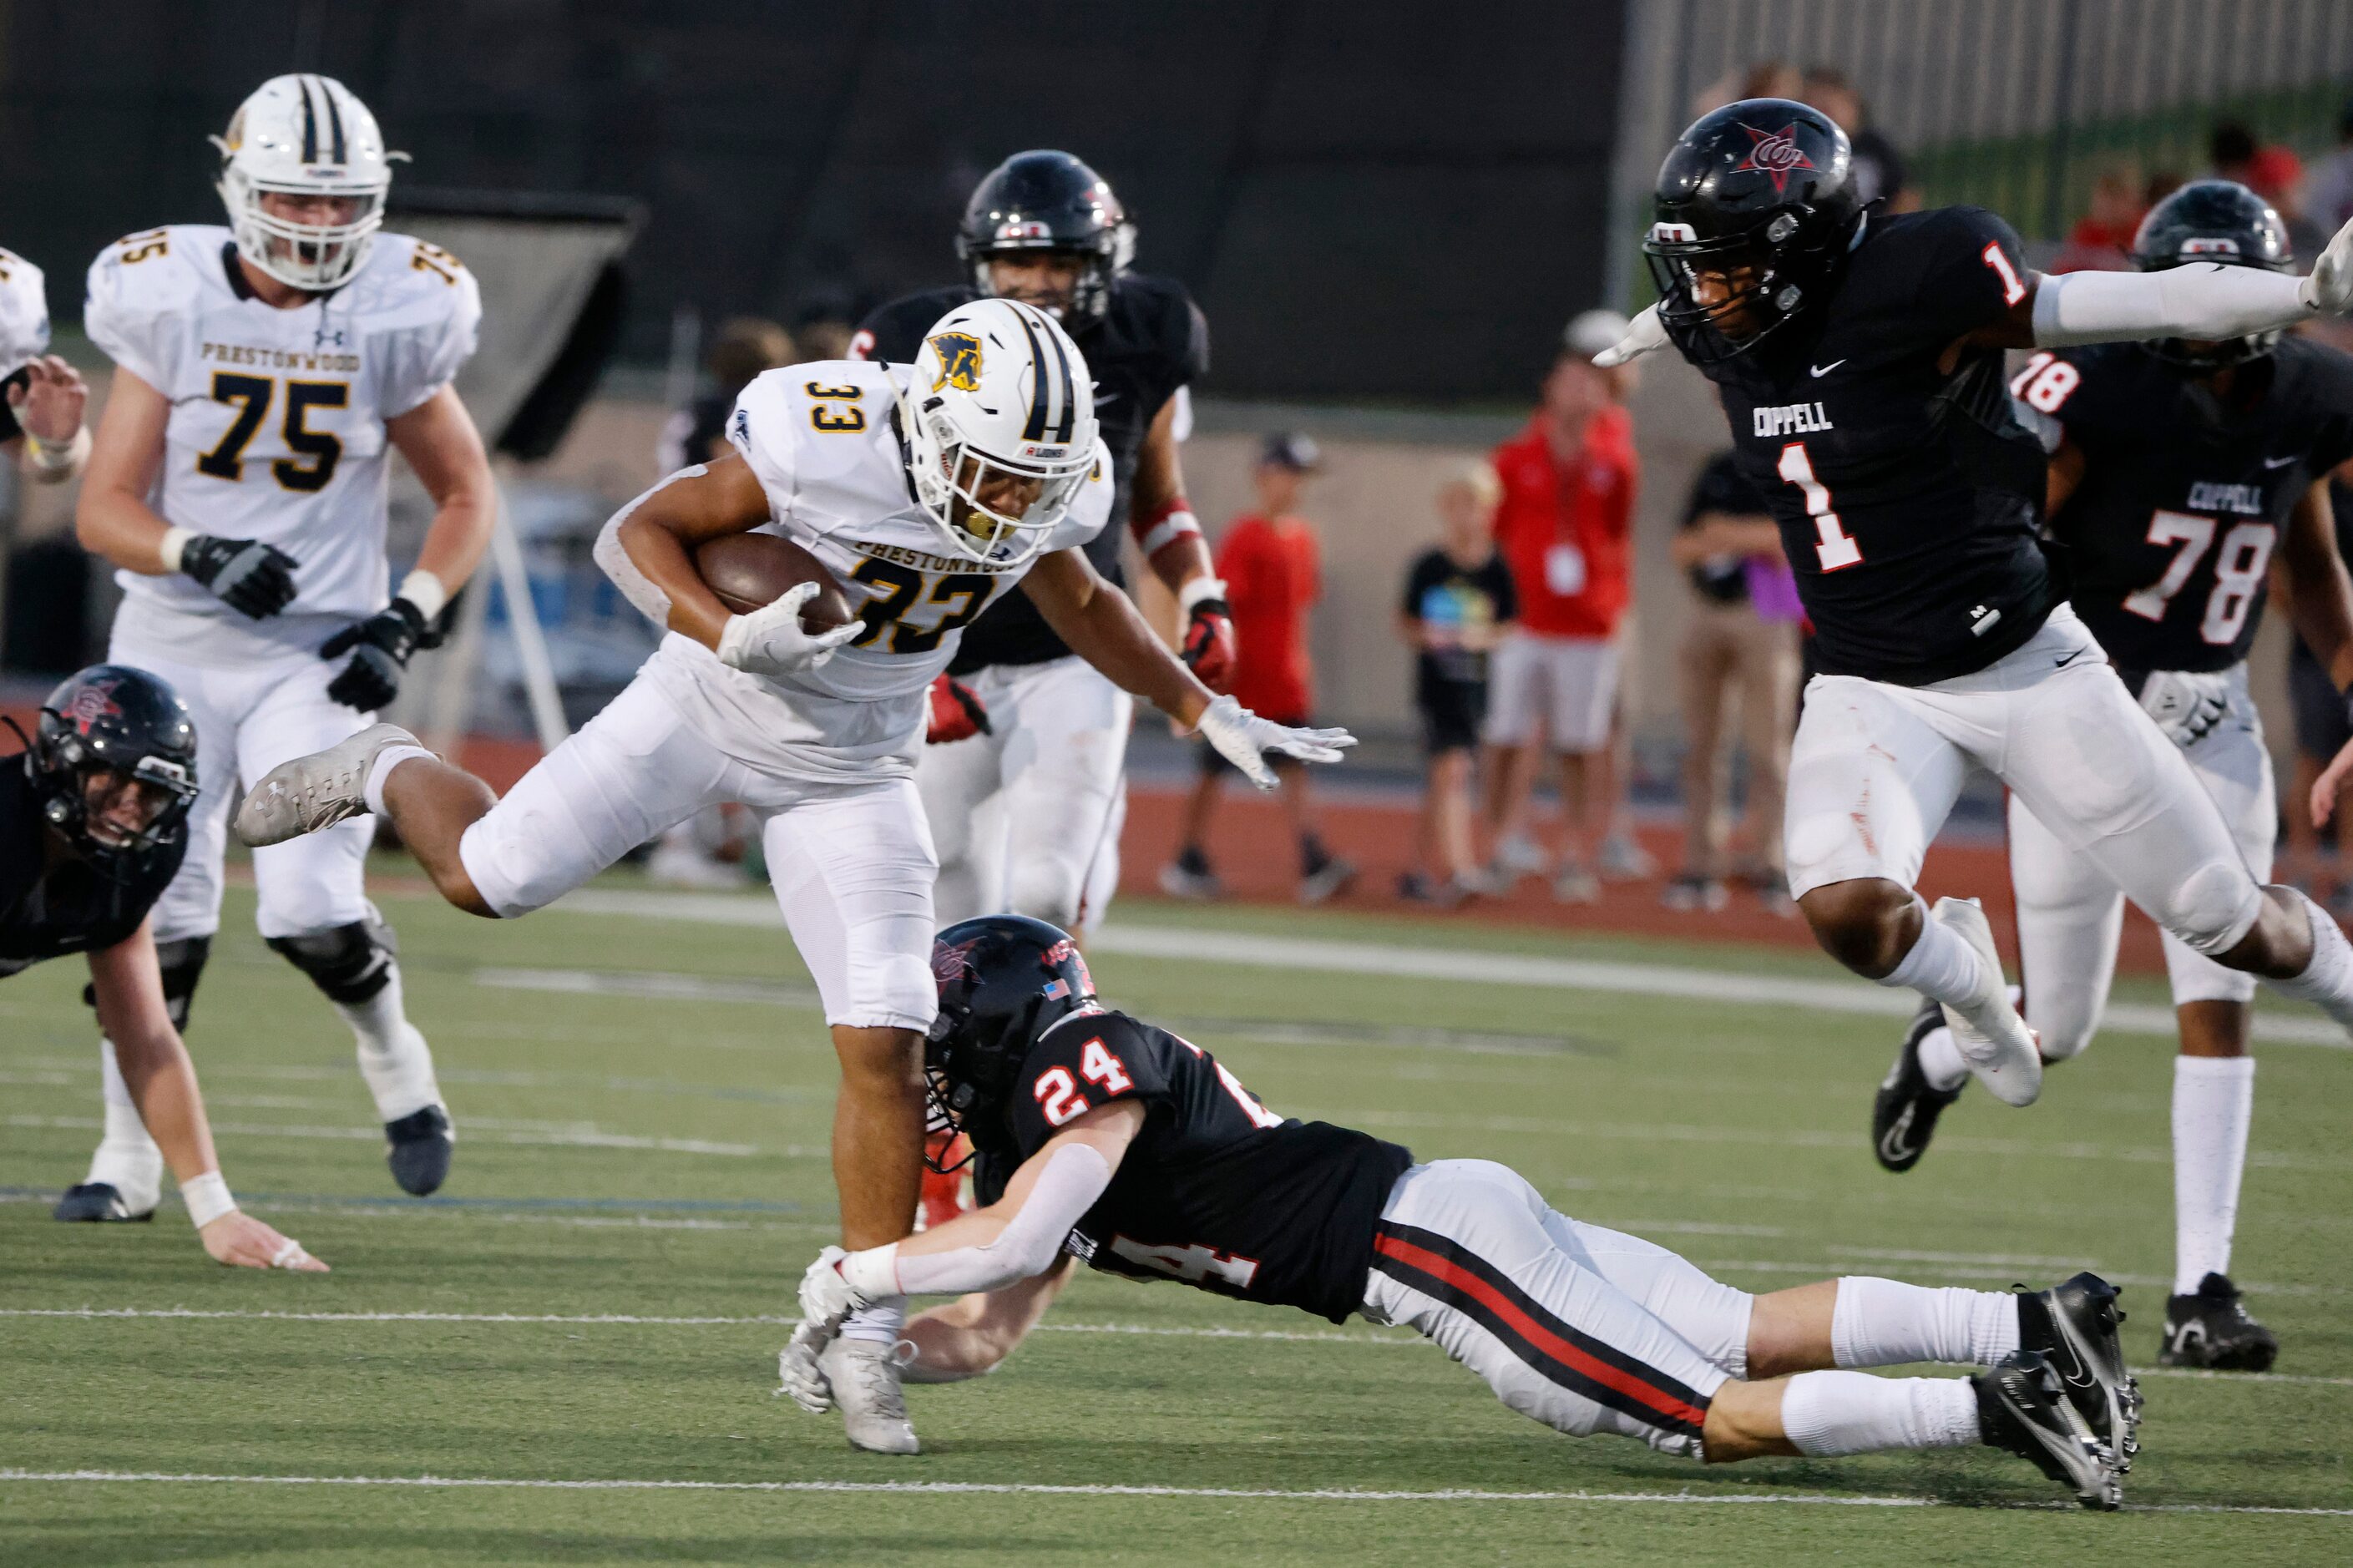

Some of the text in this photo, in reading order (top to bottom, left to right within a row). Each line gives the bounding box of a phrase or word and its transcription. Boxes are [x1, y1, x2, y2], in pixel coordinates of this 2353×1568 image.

[1981, 240, 2027, 307] 1
[201, 343, 361, 372] PRESTONWOOD
[195, 371, 350, 493] 75
[803, 381, 867, 433] 33
[1777, 442, 1865, 574] 1
[2120, 508, 2277, 645] 78
[1033, 1036, 1135, 1127] 24
